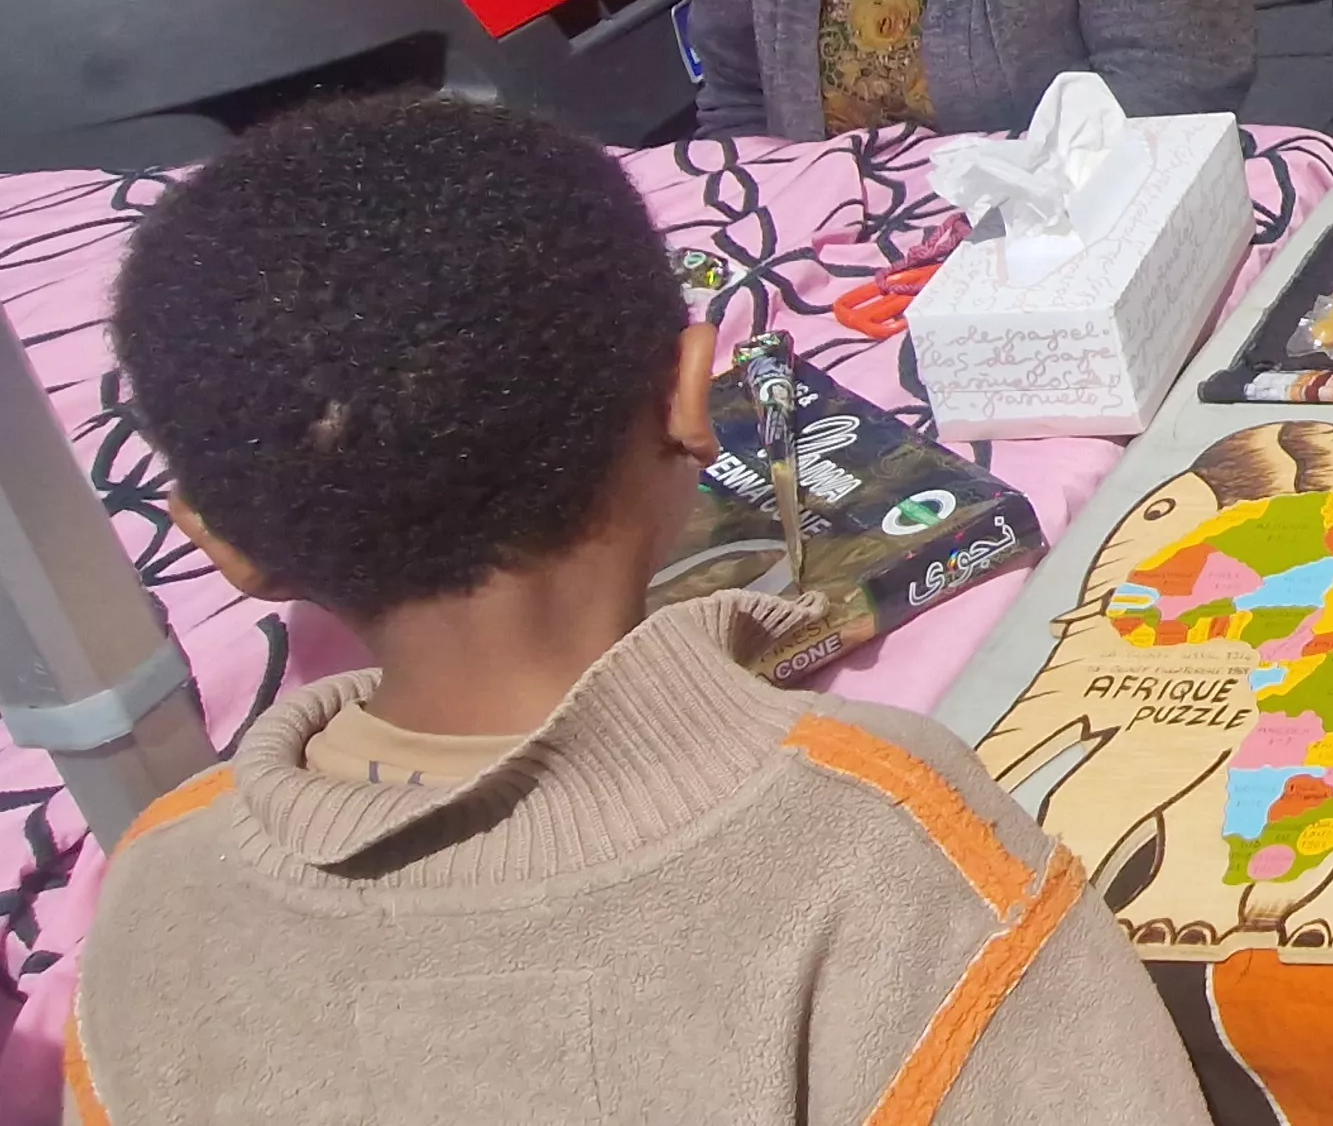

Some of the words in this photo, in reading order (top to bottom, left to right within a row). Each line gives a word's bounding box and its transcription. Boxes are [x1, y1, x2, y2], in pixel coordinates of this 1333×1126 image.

[774, 633, 843, 681] CONE
[1083, 675, 1239, 704] AFRIQUE
[1125, 704, 1253, 733] PUZZLE
